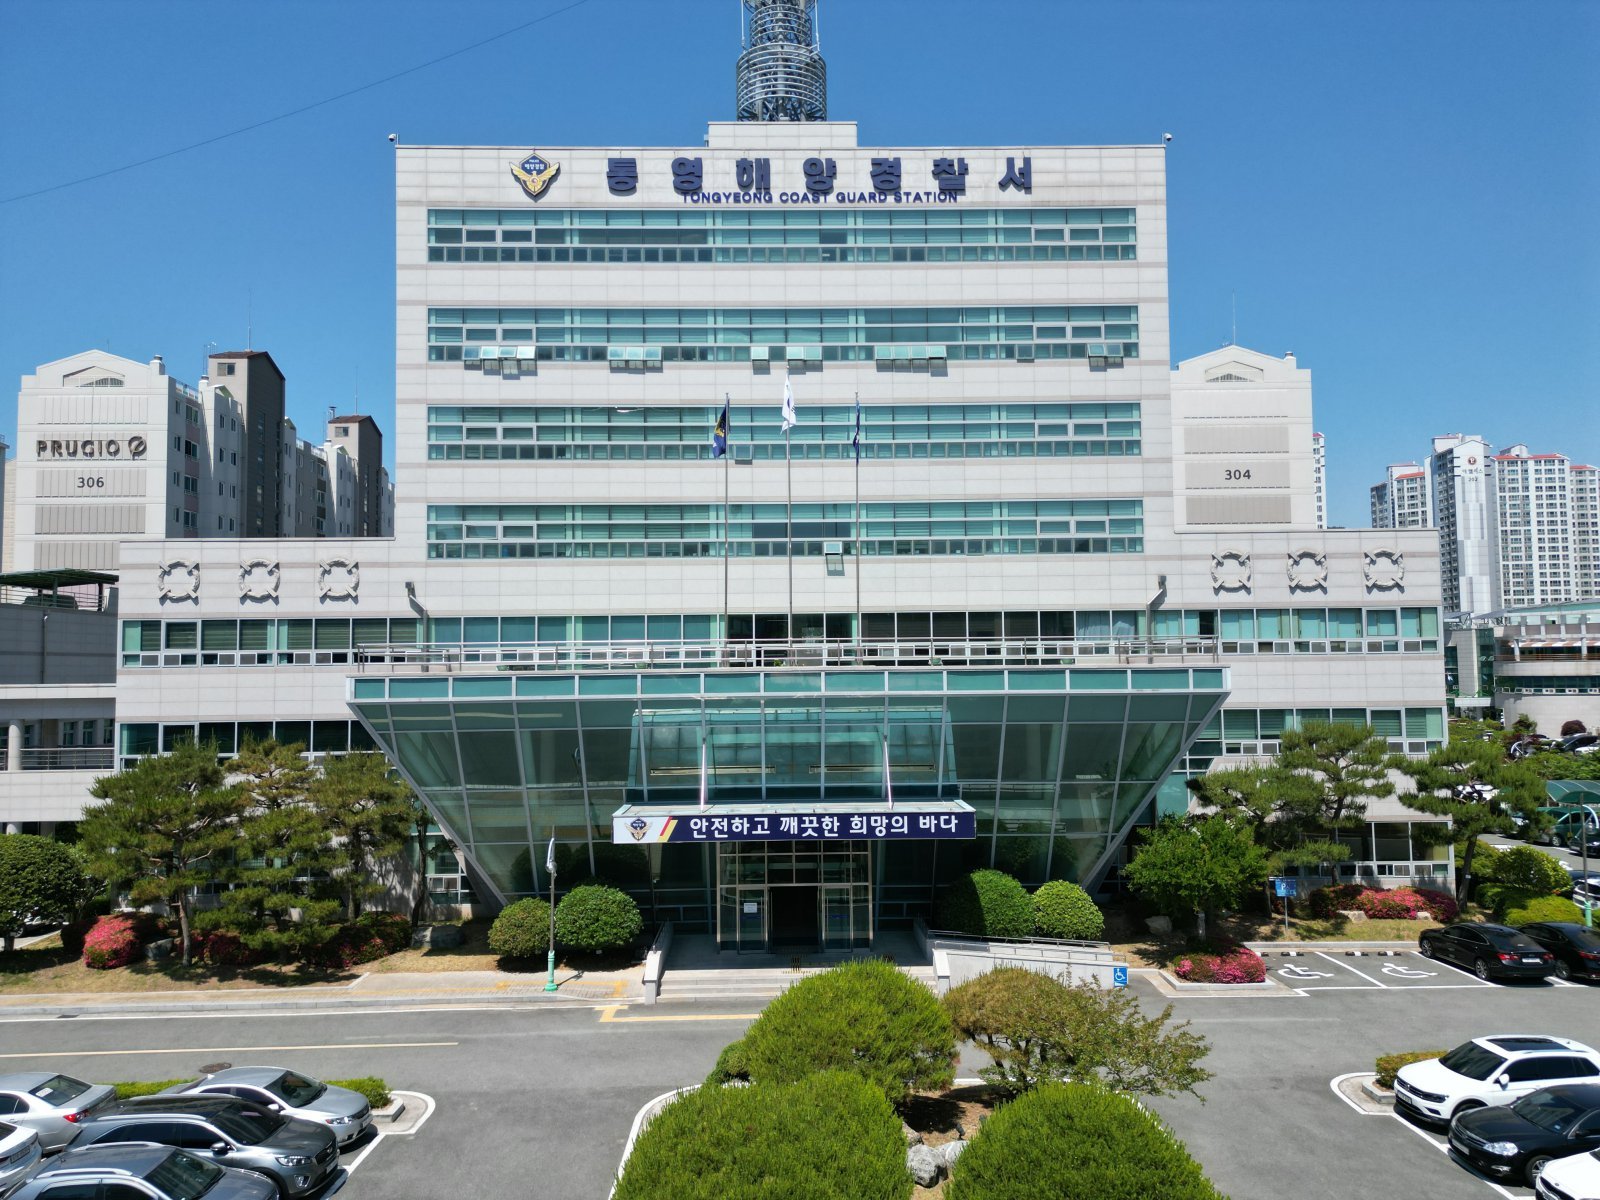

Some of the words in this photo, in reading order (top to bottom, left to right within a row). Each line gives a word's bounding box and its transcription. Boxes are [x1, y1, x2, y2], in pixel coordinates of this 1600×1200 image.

[606, 157, 1033, 193] 통영해양경찰서
[682, 191, 772, 203] TONGYEONG
[779, 191, 828, 203] COAST
[835, 191, 887, 203] GUARD
[893, 191, 958, 203] STATION
[36, 440, 120, 457] PRUGIO
[1224, 469, 1251, 480] 304
[77, 477, 104, 488] 306
[690, 817, 770, 838] 안전하고
[780, 816, 840, 837] 깨끗한
[850, 815, 907, 836] 희망의
[919, 815, 958, 832] 바다
